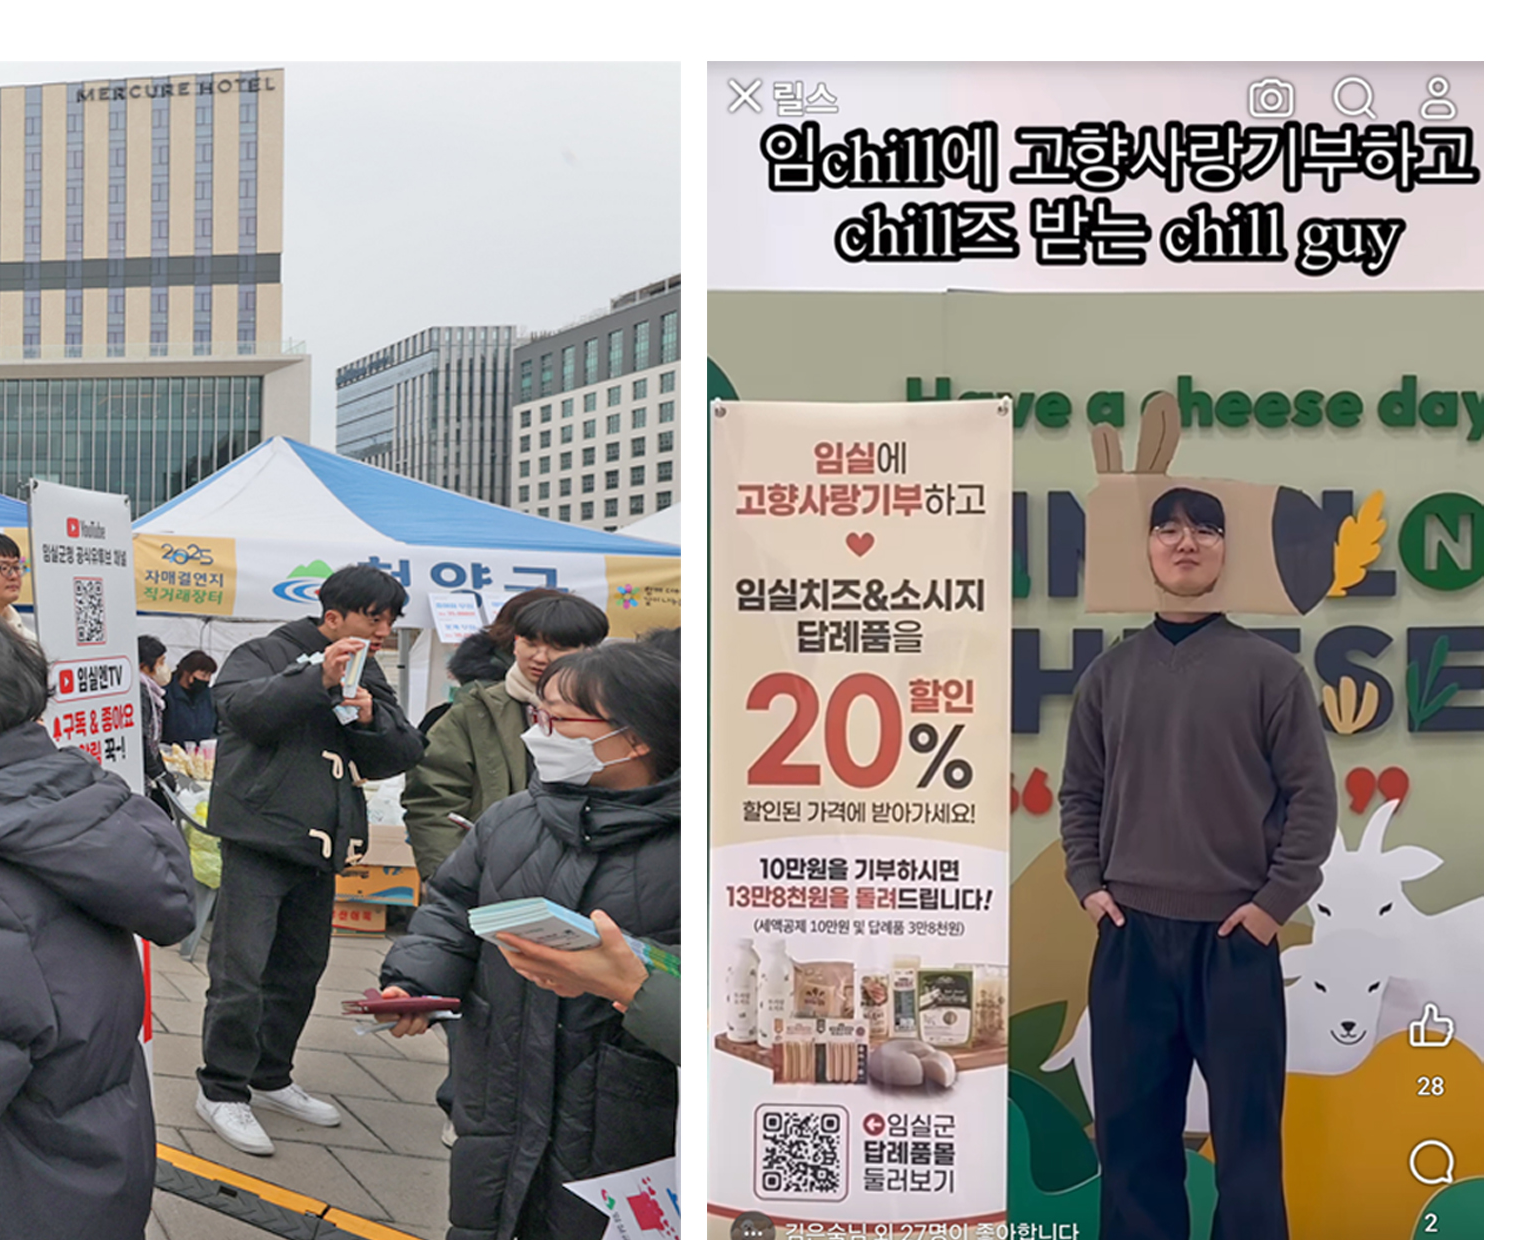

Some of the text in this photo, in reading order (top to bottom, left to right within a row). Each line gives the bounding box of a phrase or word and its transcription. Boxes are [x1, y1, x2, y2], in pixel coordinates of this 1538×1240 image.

[76, 77, 277, 103] MERCURE HOTEL
[773, 81, 839, 117] 릴스
[813, 441, 907, 475] 임실에
[735, 483, 986, 517] 고향사랑기부하고
[161, 543, 213, 566] 2025
[144, 571, 224, 588] 자매결연지
[143, 586, 224, 605] 직거래장터
[735, 578, 985, 612] 임실치즈&소시지
[797, 620, 924, 654] 답례품을
[77, 665, 123, 693] 임실엔TV
[909, 679, 975, 714] 할인
[63, 703, 135, 740] 구독 좋아요
[742, 801, 975, 824] 할인된 가격에 받아가세요!
[760, 857, 960, 882] 10만원을 기부하시면
[726, 885, 993, 911] 13만8천원을 돌려드립니다!
[754, 918, 965, 937] (세액공제 10만원 답례품 3만8천원)
[1417, 1076, 1445, 1097] 28
[887, 1113, 956, 1139] 임실군
[864, 1140, 955, 1166] 답례품몰
[863, 1168, 954, 1194] 둘러보기
[1423, 1213, 1438, 1233] 2
